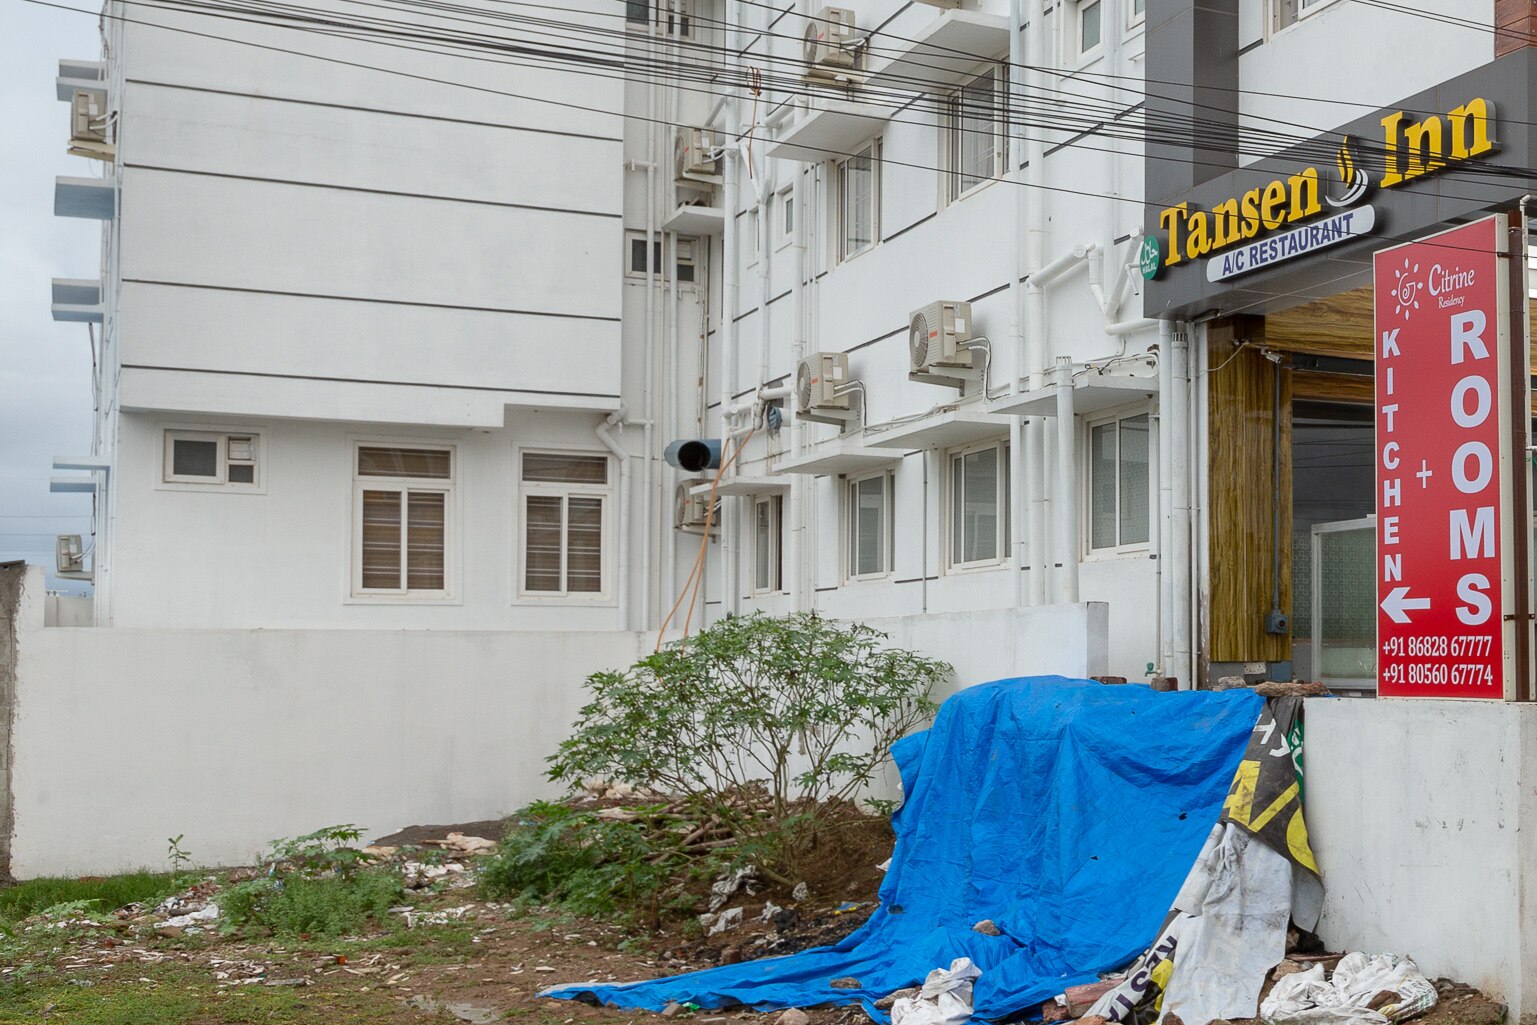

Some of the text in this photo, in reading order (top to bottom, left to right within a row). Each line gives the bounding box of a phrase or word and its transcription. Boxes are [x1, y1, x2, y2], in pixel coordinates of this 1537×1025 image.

[1160, 97, 1499, 267] Tansen Inn
[1222, 213, 1354, 276] A/C RESTAURANT
[1428, 262, 1476, 297] Citrine
[1438, 294, 1465, 309] Residency
[1382, 326, 1402, 583] KITCHEN
[1449, 308, 1496, 627] ROOMS
[1382, 635, 1493, 658] +91 86828 67777
[1383, 663, 1494, 686] +91 80560 67774
